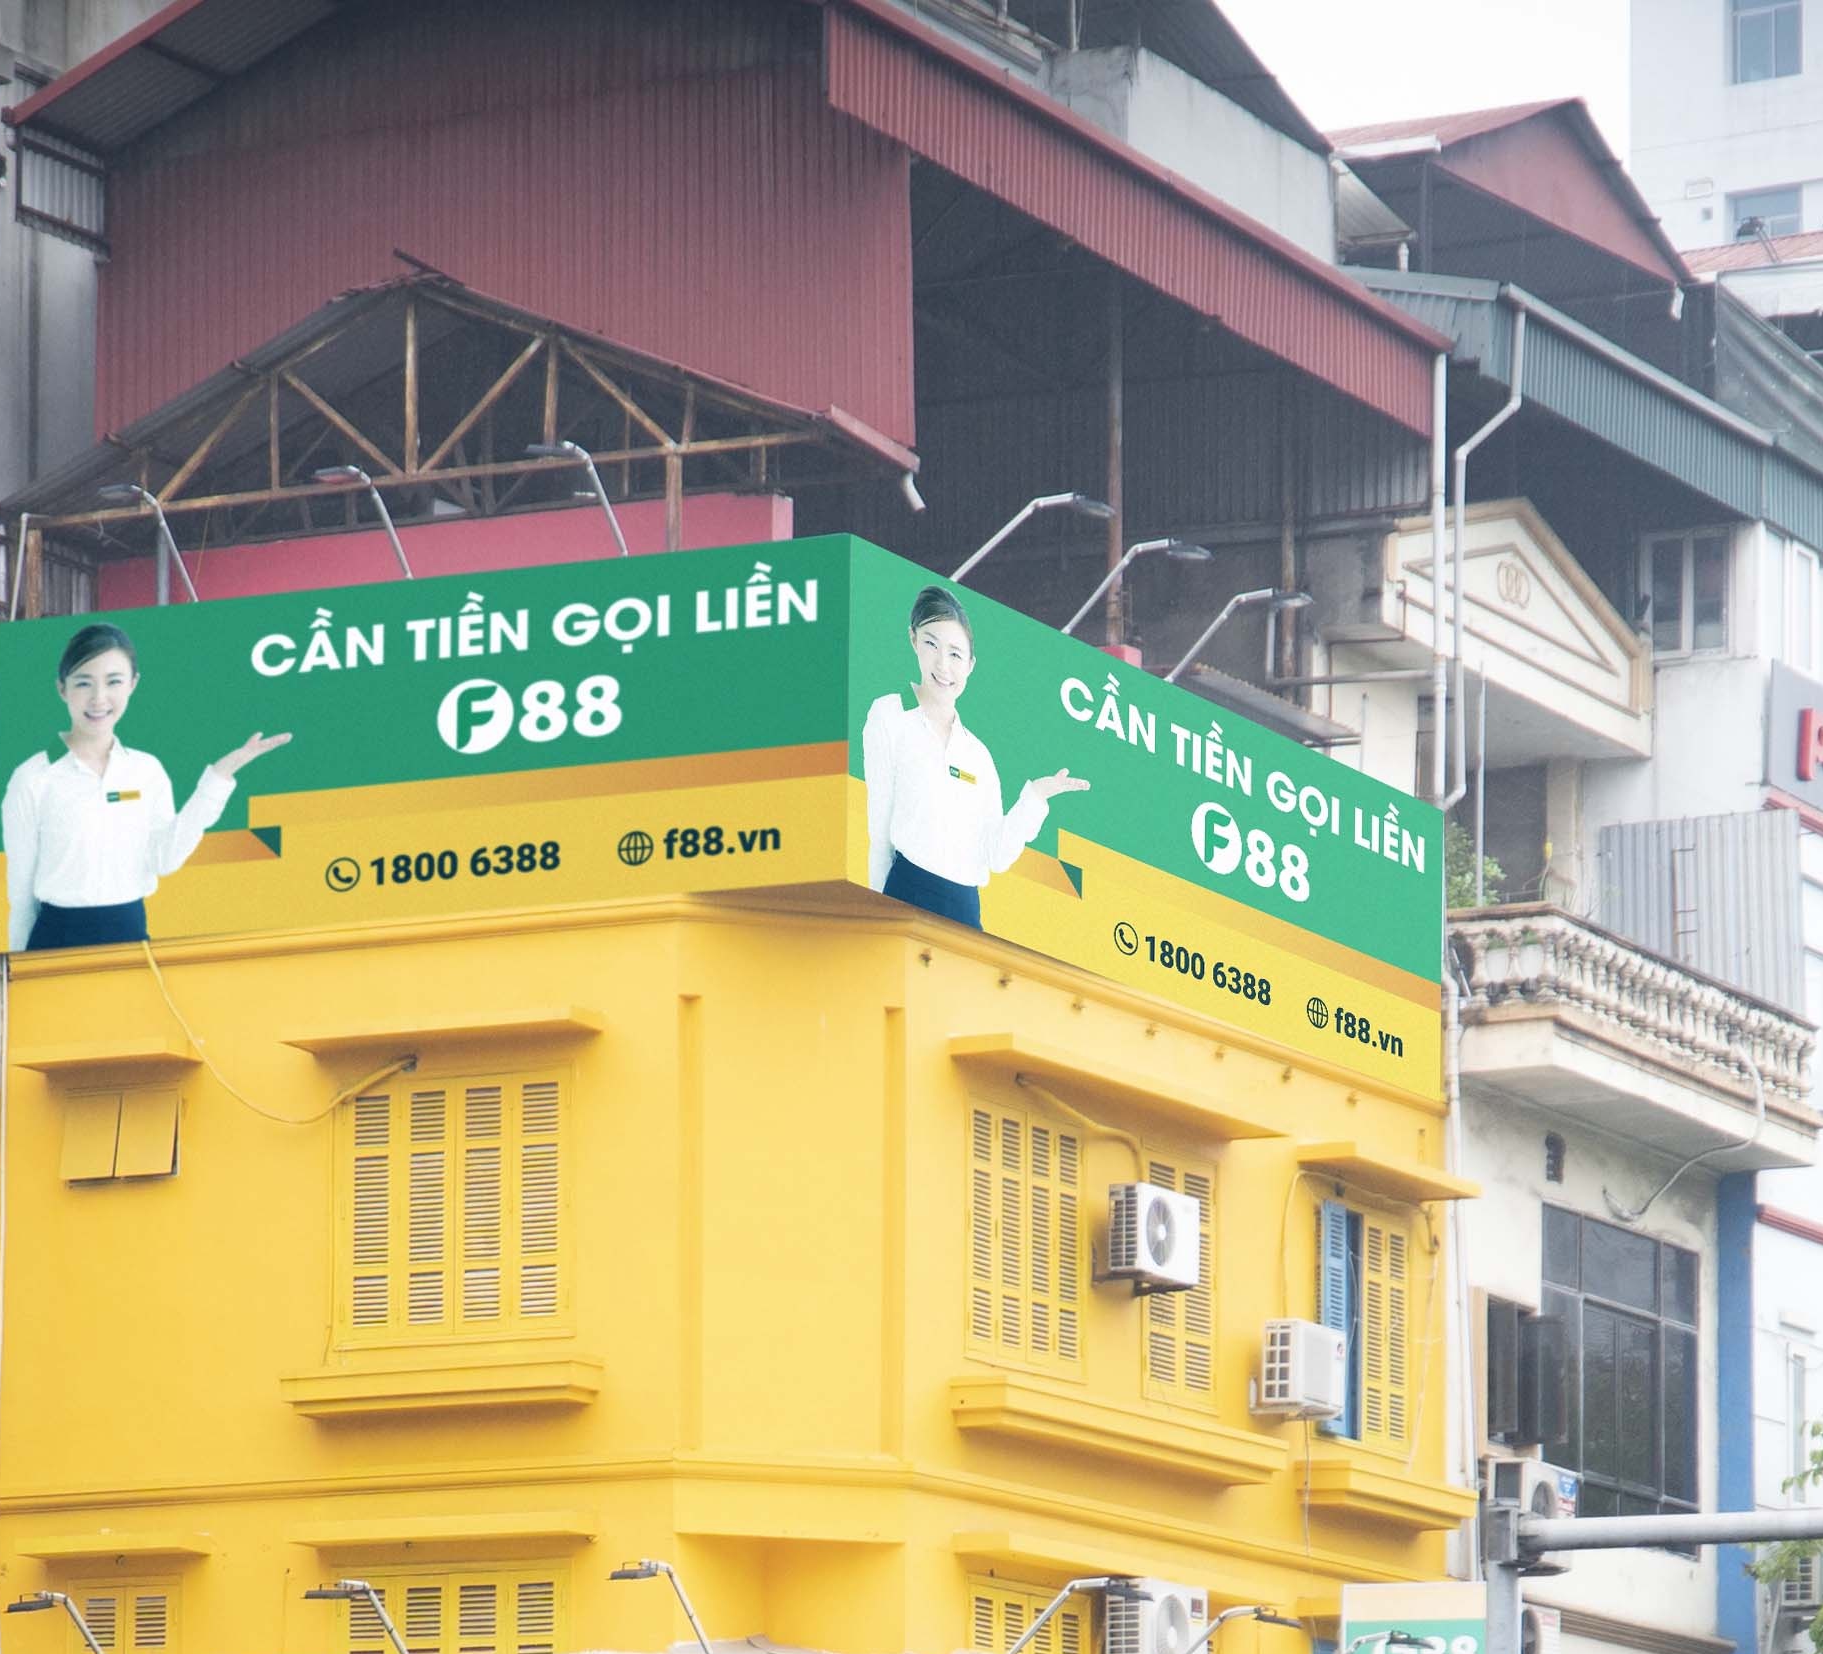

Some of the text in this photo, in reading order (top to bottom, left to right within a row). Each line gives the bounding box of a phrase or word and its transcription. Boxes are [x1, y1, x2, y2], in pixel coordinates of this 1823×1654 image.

[249, 562, 821, 679] CẦN TIỀN GỌI LIỀN
[437, 674, 624, 755] F88
[1059, 672, 1426, 875] CẦN TIỀN GỌI LIỀN
[368, 824, 783, 887] 1800 6388 f88.vn
[1190, 801, 1311, 903] F88
[1144, 934, 1404, 1059] 1800 6388 f88.vn
